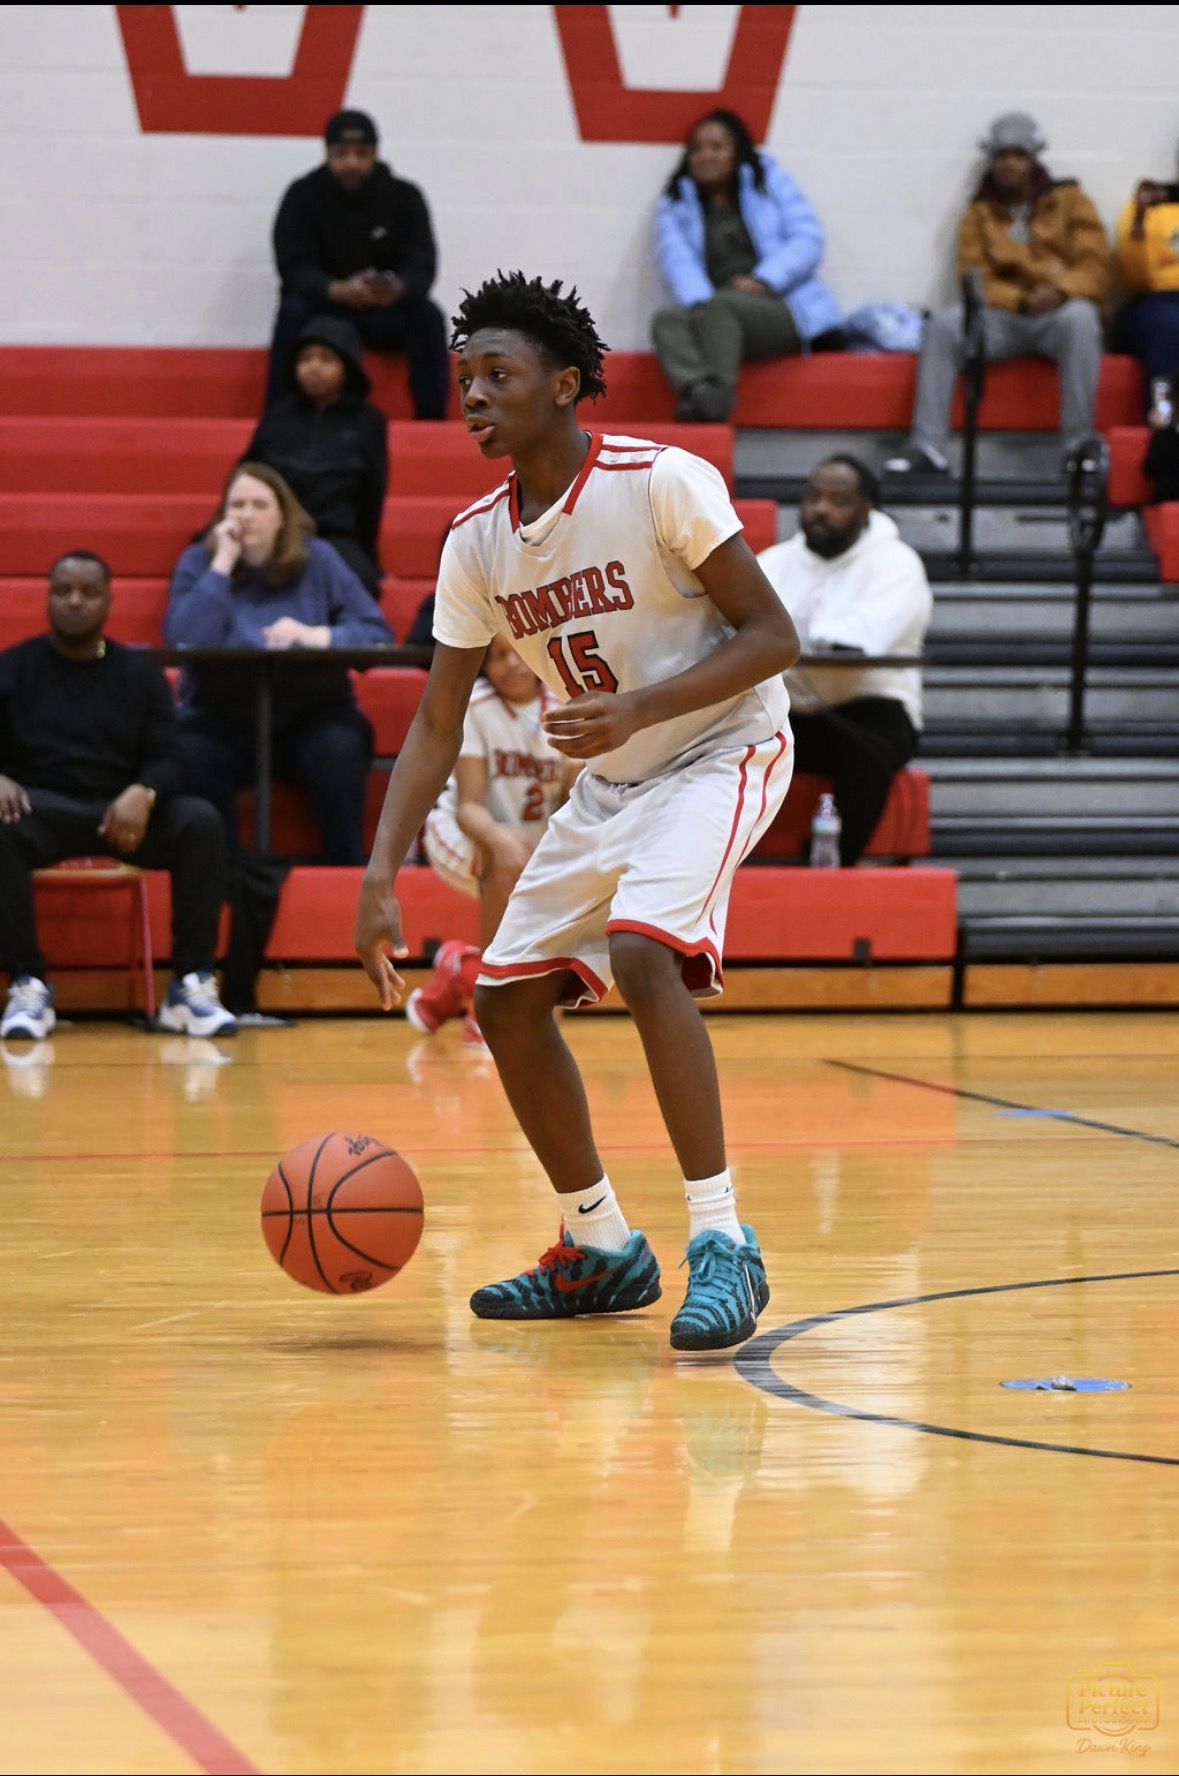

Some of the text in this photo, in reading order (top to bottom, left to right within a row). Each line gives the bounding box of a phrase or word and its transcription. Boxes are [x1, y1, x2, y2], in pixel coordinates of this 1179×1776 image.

[495, 560, 635, 640] BOMBERS
[547, 630, 619, 699] 15
[522, 783, 545, 822] 2
